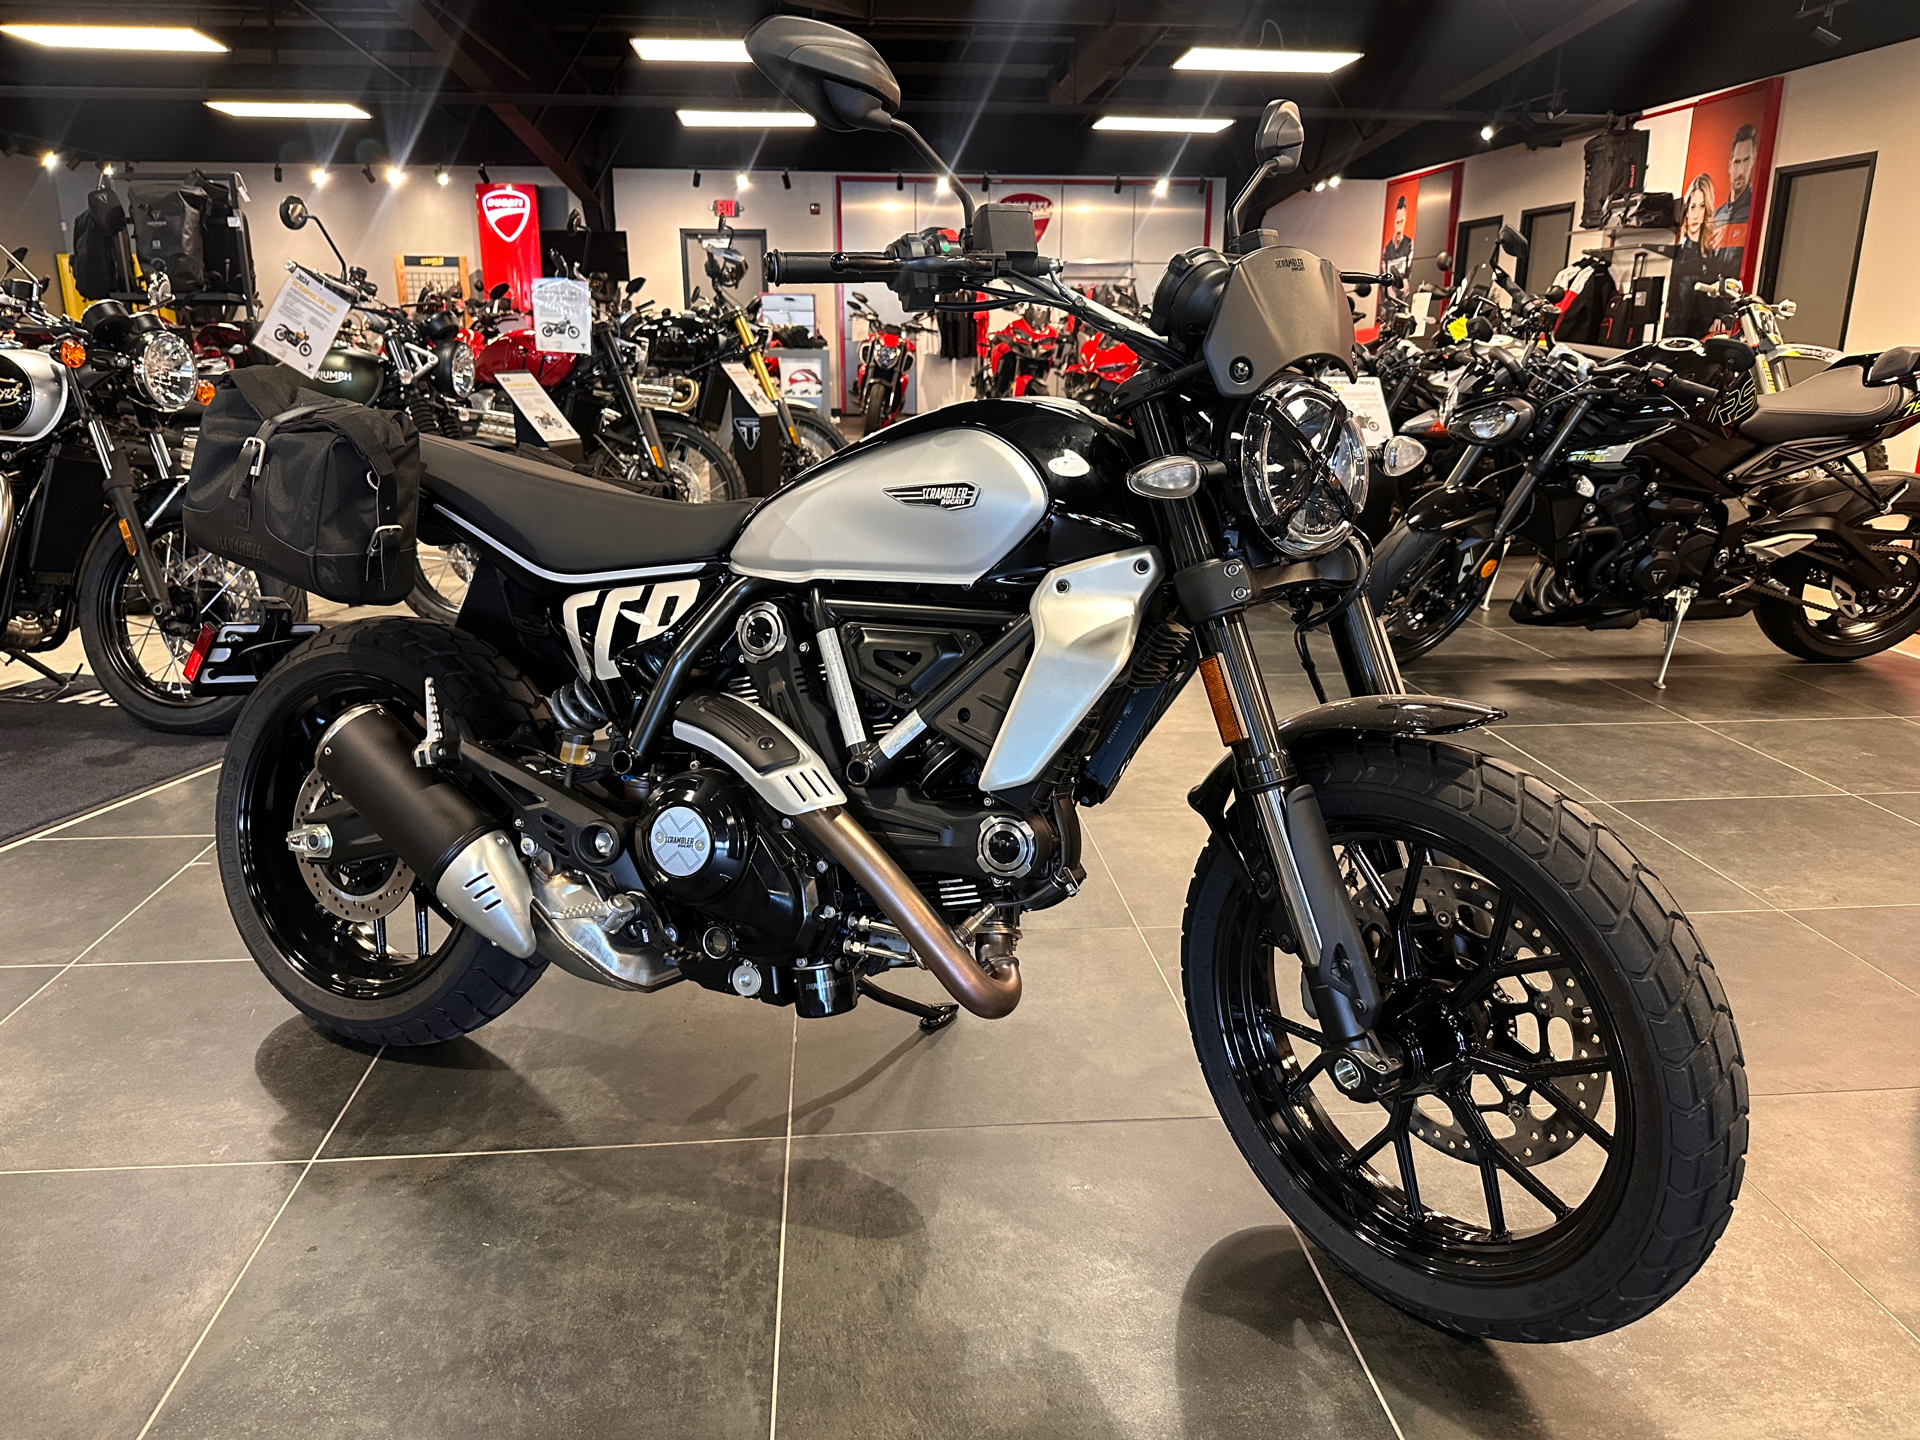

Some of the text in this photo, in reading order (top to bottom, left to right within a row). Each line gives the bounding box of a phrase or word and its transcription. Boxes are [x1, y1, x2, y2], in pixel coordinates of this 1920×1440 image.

[486, 197, 524, 208] DUCATI
[717, 200, 735, 216] EXIT
[1274, 258, 1304, 267] SCRAMBLER
[315, 370, 352, 381] RIUMPH
[922, 486, 969, 499] SCRAMBLER
[664, 835, 695, 845] SCRAMBLER
